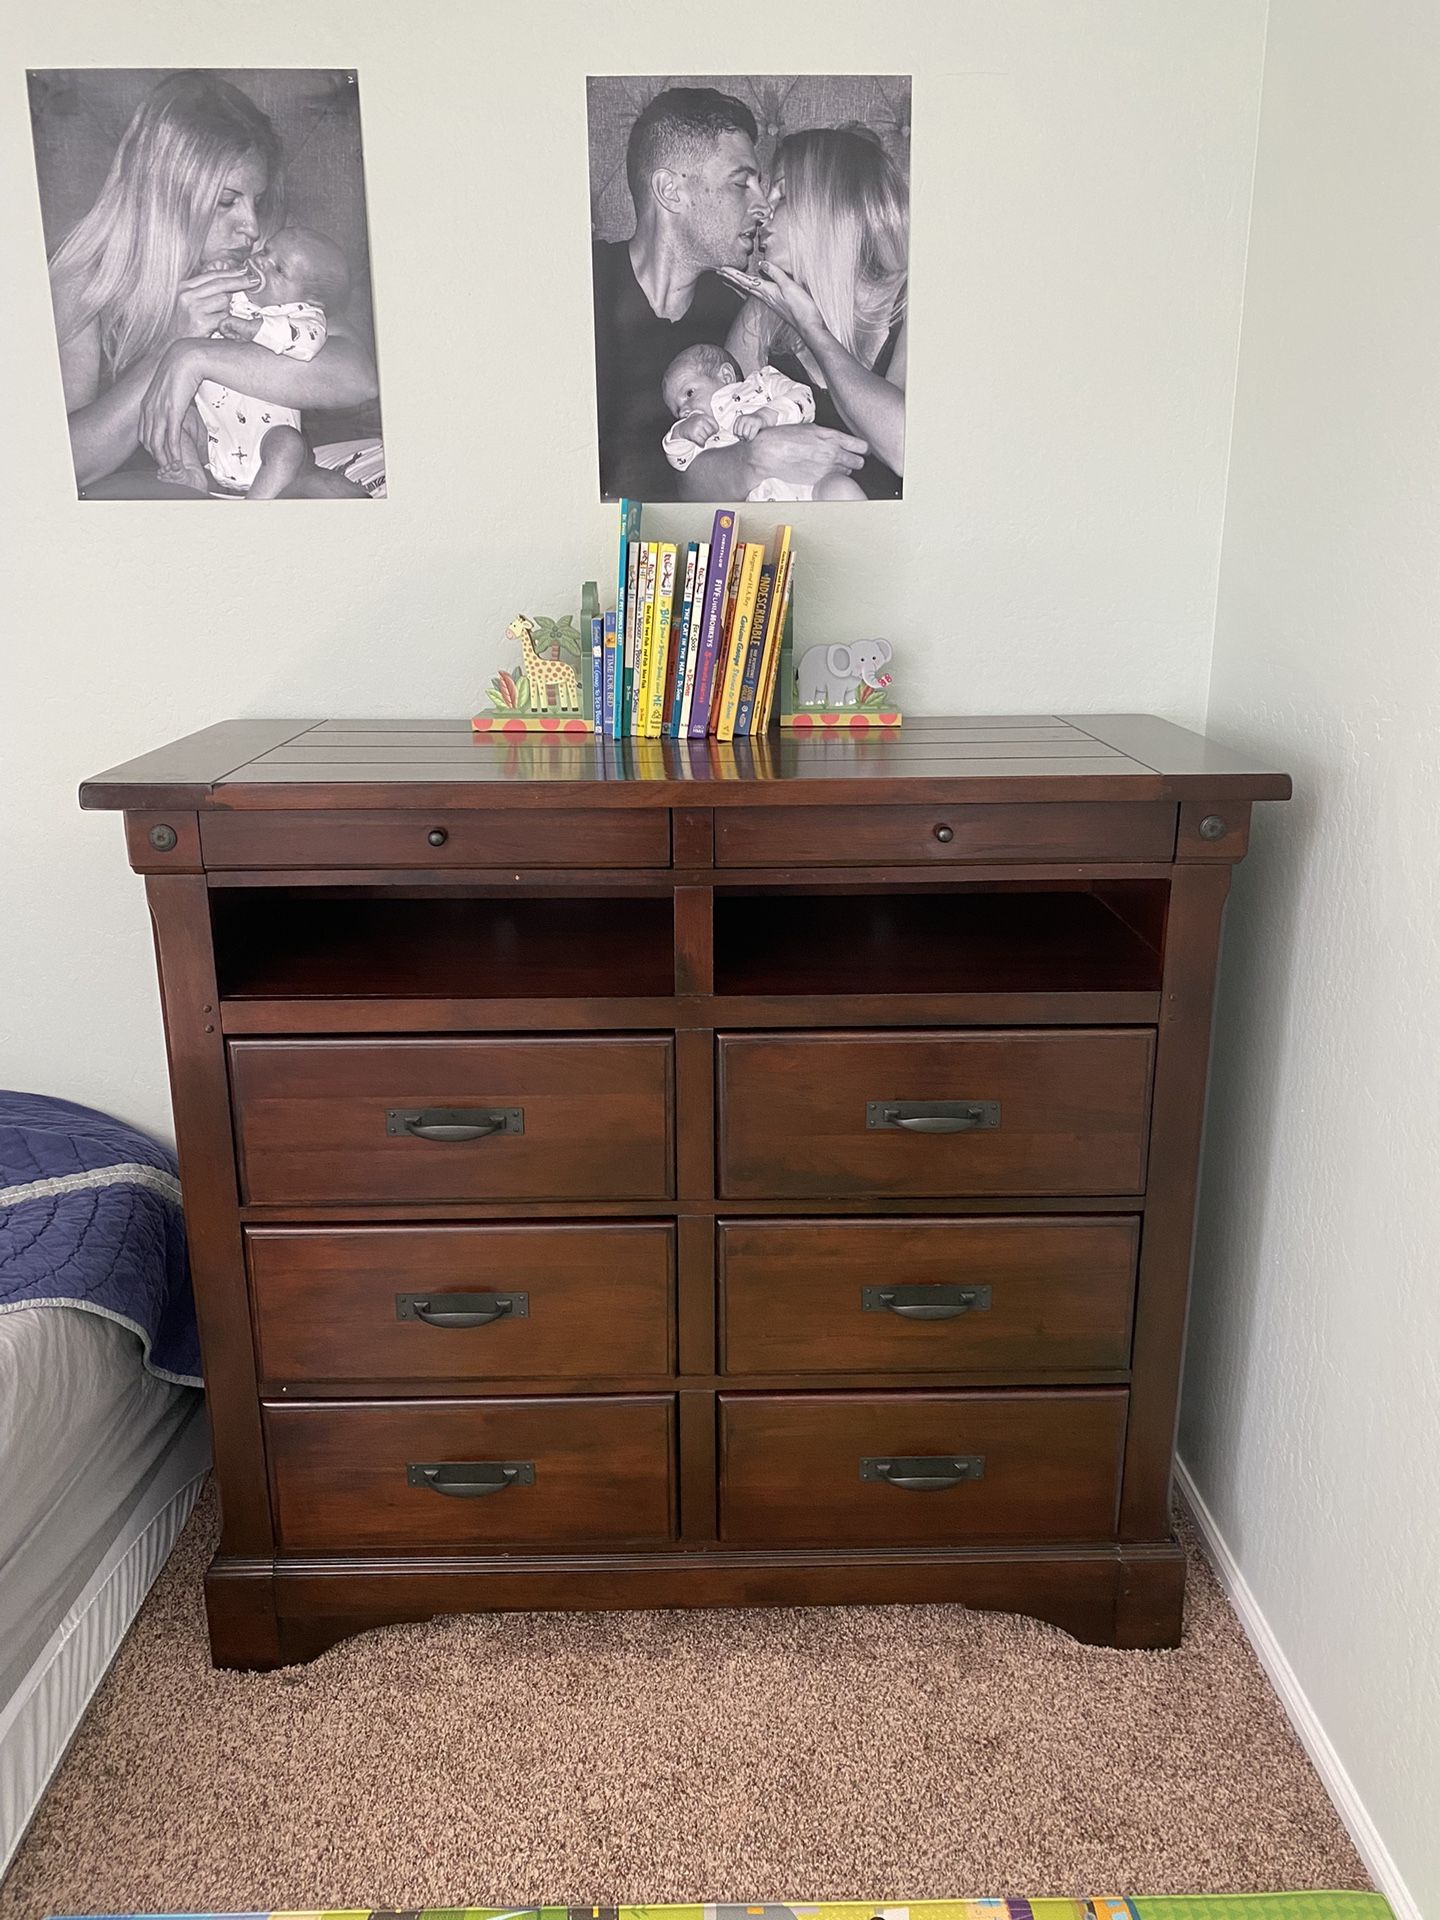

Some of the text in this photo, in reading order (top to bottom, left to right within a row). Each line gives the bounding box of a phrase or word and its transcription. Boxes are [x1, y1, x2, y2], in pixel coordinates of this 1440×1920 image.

[713, 579, 722, 597] FIVE
[660, 608, 670, 625] BIG
[750, 576, 771, 646] INDESCRIBABLE
[706, 614, 718, 648] MONKEYS
[738, 615, 748, 641] Curious
[681, 638, 688, 646] IN
[734, 643, 743, 667] George
[653, 695, 662, 707] ME
